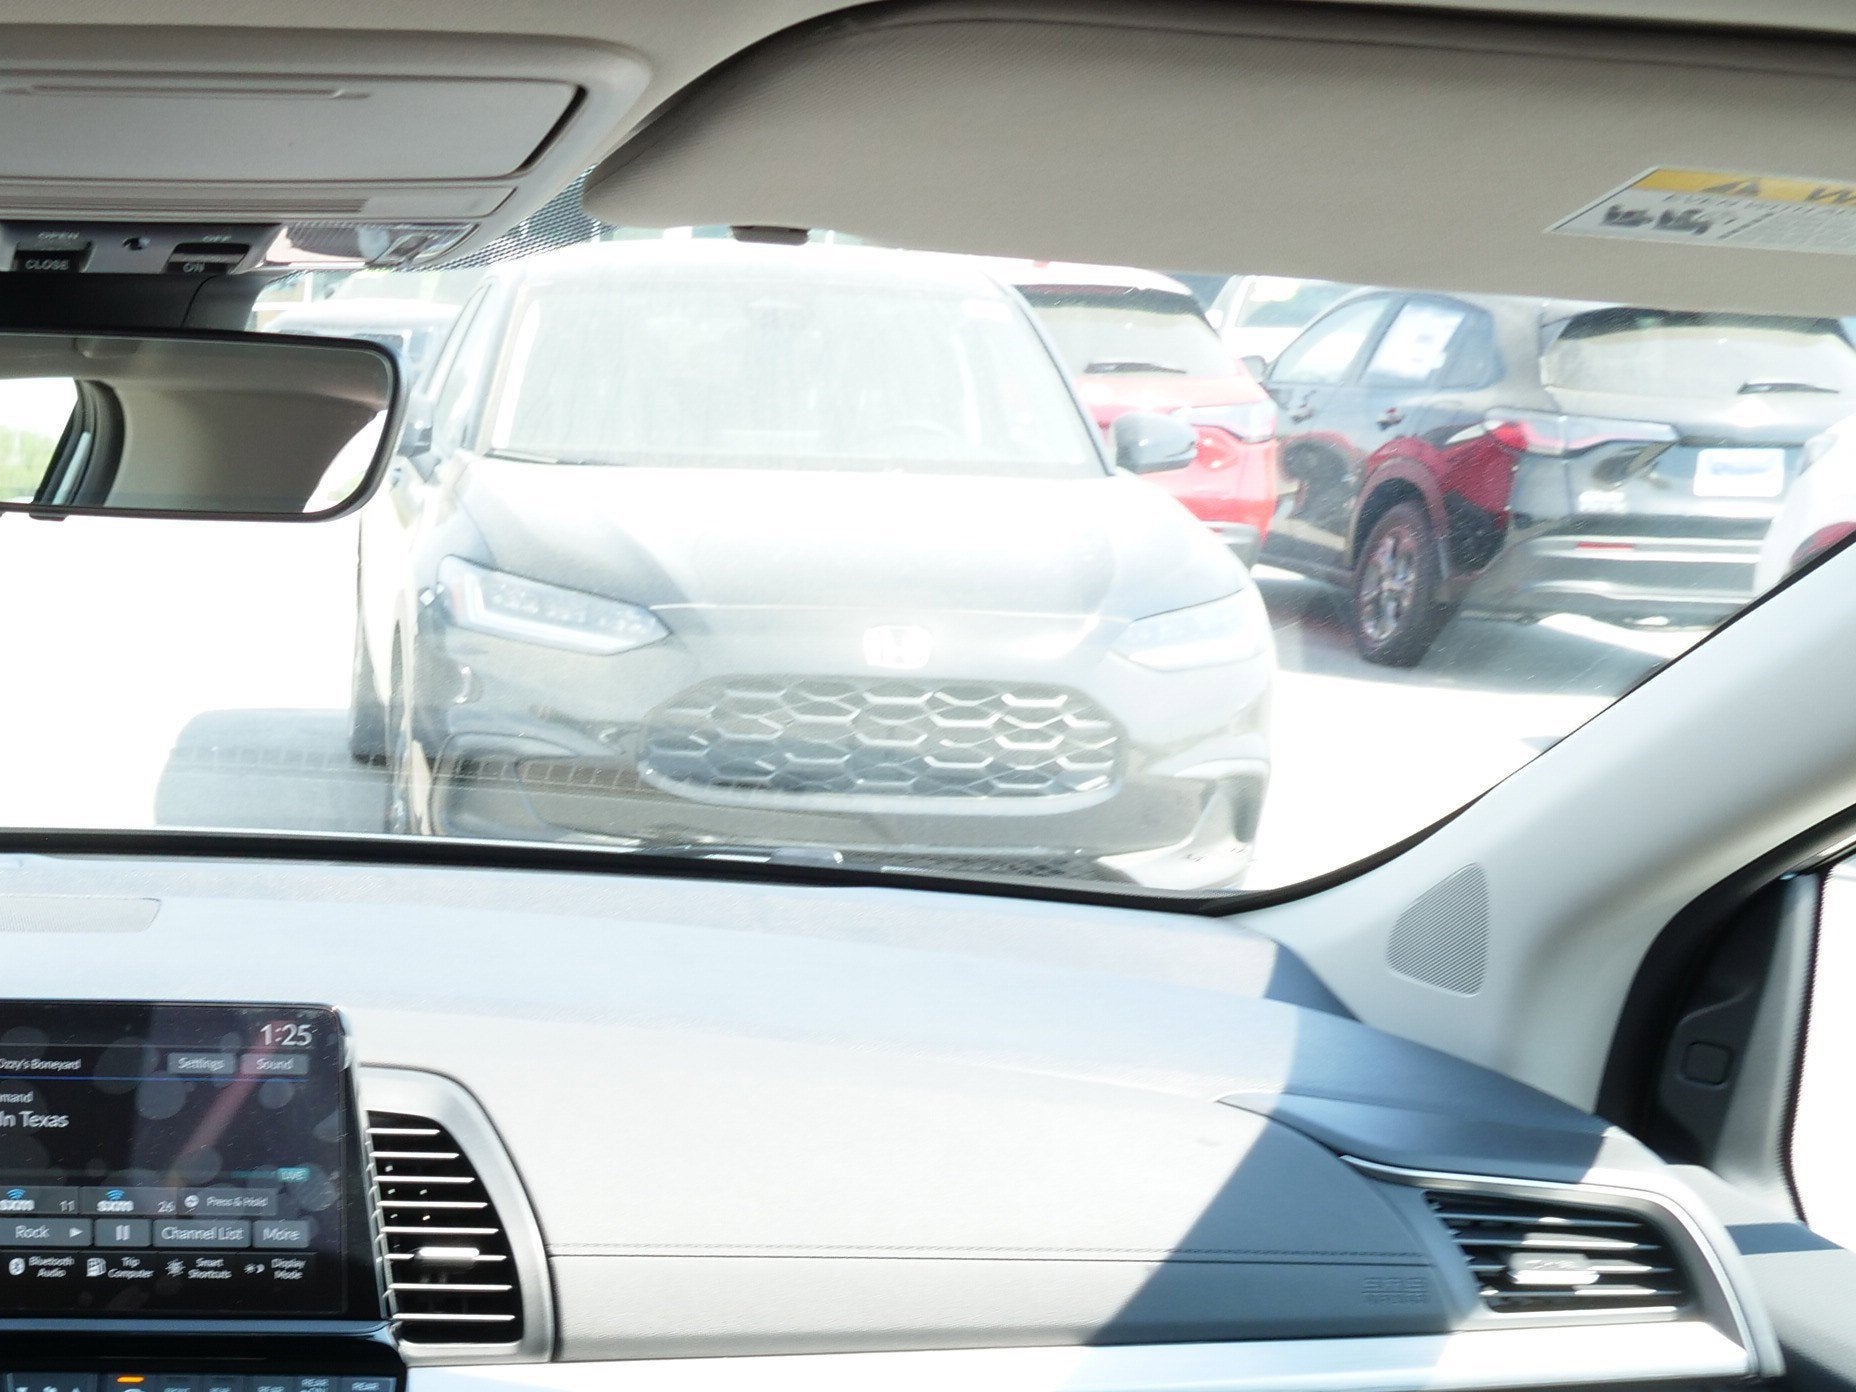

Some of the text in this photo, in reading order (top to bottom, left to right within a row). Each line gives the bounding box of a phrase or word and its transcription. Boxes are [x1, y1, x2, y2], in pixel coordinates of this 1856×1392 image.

[25, 259, 70, 271] CLOSE
[183, 262, 205, 273] ON
[260, 1023, 313, 1046] 1:25
[30, 1058, 82, 1072] Boneyard
[177, 1057, 225, 1071] Settings
[256, 1057, 293, 1071] Sound
[18, 1110, 70, 1128] Texas
[59, 1200, 75, 1211] 11
[157, 1201, 176, 1213] 26
[15, 1225, 50, 1239] Rock
[161, 1226, 245, 1240] Channel List
[262, 1227, 300, 1240] More
[29, 1256, 76, 1267] Bluetooth
[121, 1256, 141, 1267] Trip
[195, 1257, 225, 1268] Smart
[270, 1258, 307, 1269] Display
[37, 1267, 67, 1278] Audio
[107, 1268, 154, 1279] Computer
[187, 1269, 233, 1280] Shortcuts
[273, 1269, 303, 1280] Mode
